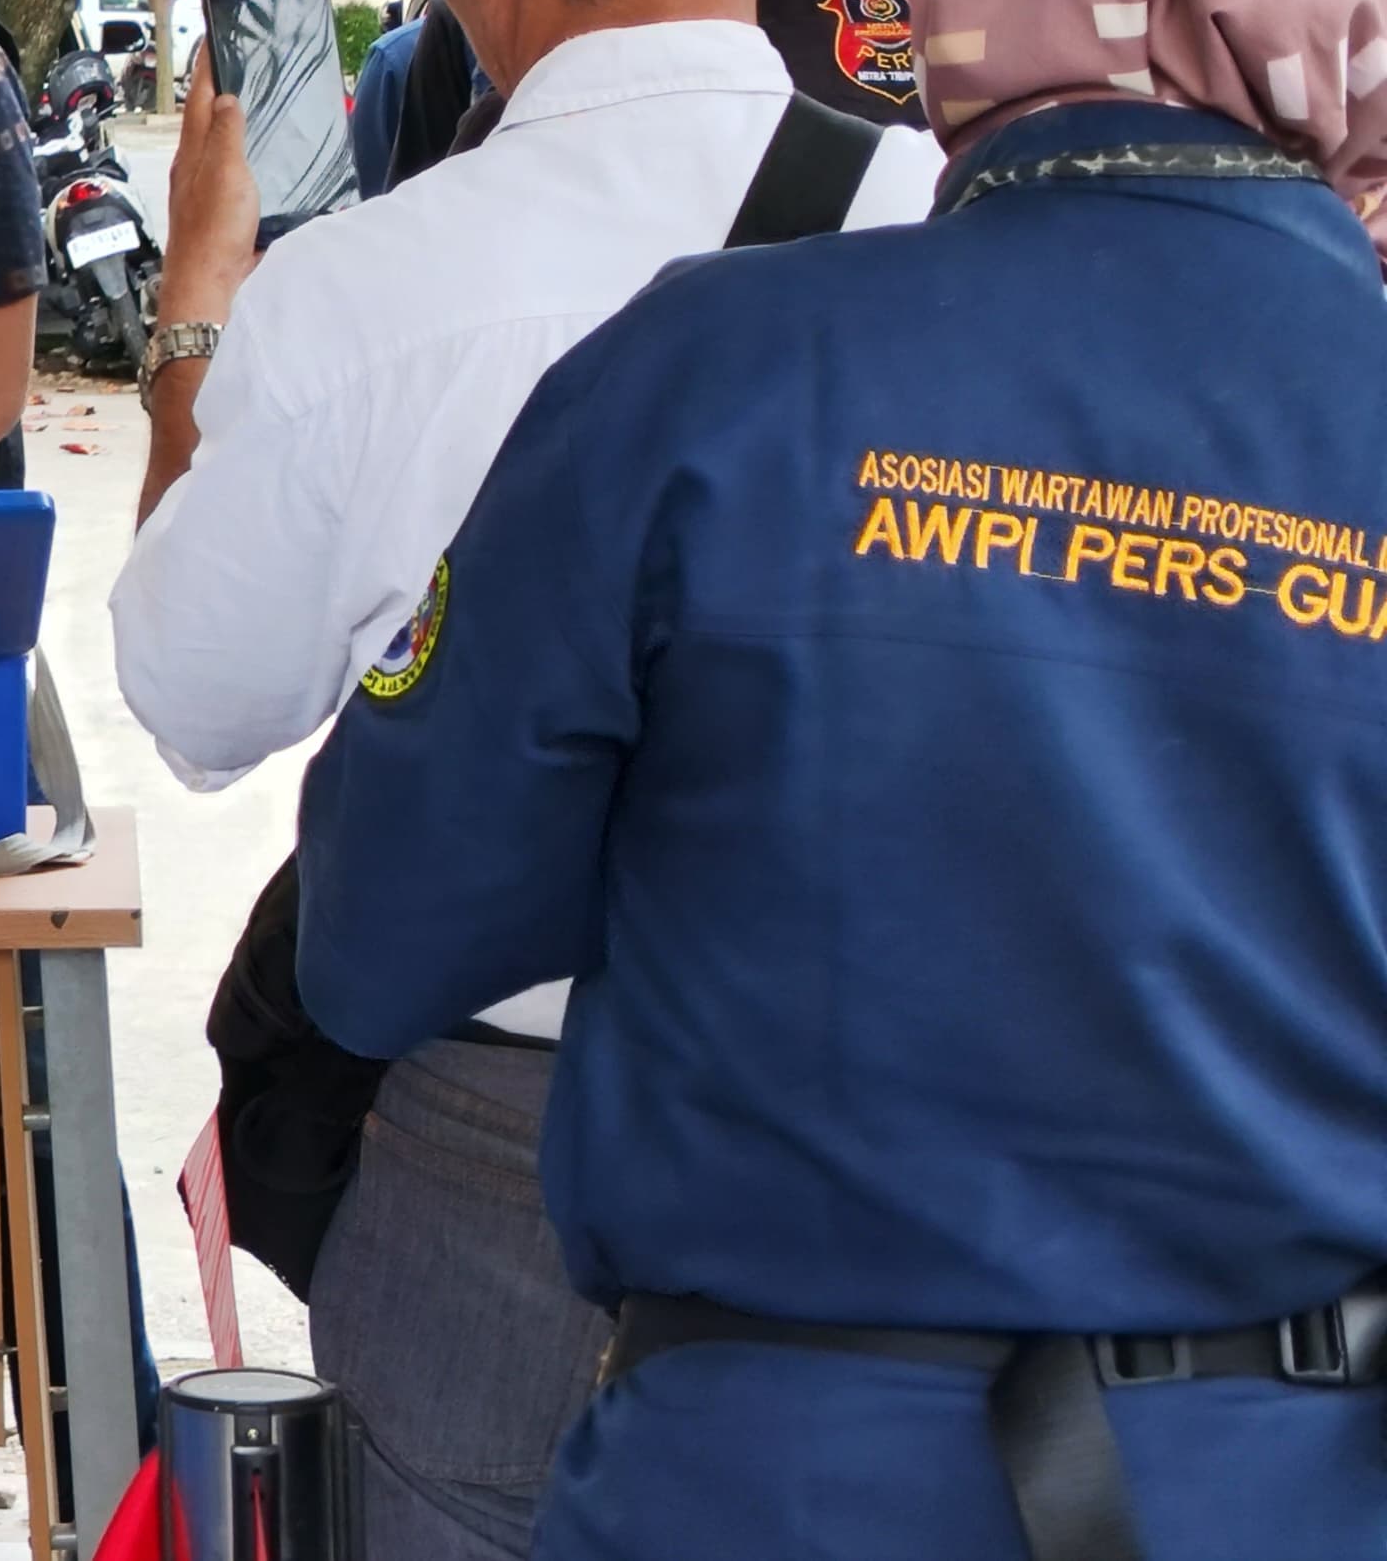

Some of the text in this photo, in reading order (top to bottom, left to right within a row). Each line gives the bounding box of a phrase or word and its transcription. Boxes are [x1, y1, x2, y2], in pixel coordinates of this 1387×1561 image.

[855, 498, 1039, 576] AWPI
[1064, 524, 1248, 606] PERS
[858, 450, 991, 501] ASOSIASI
[1000, 468, 1176, 530] WARTAWAN
[1179, 494, 1369, 568] PROFESIONAL
